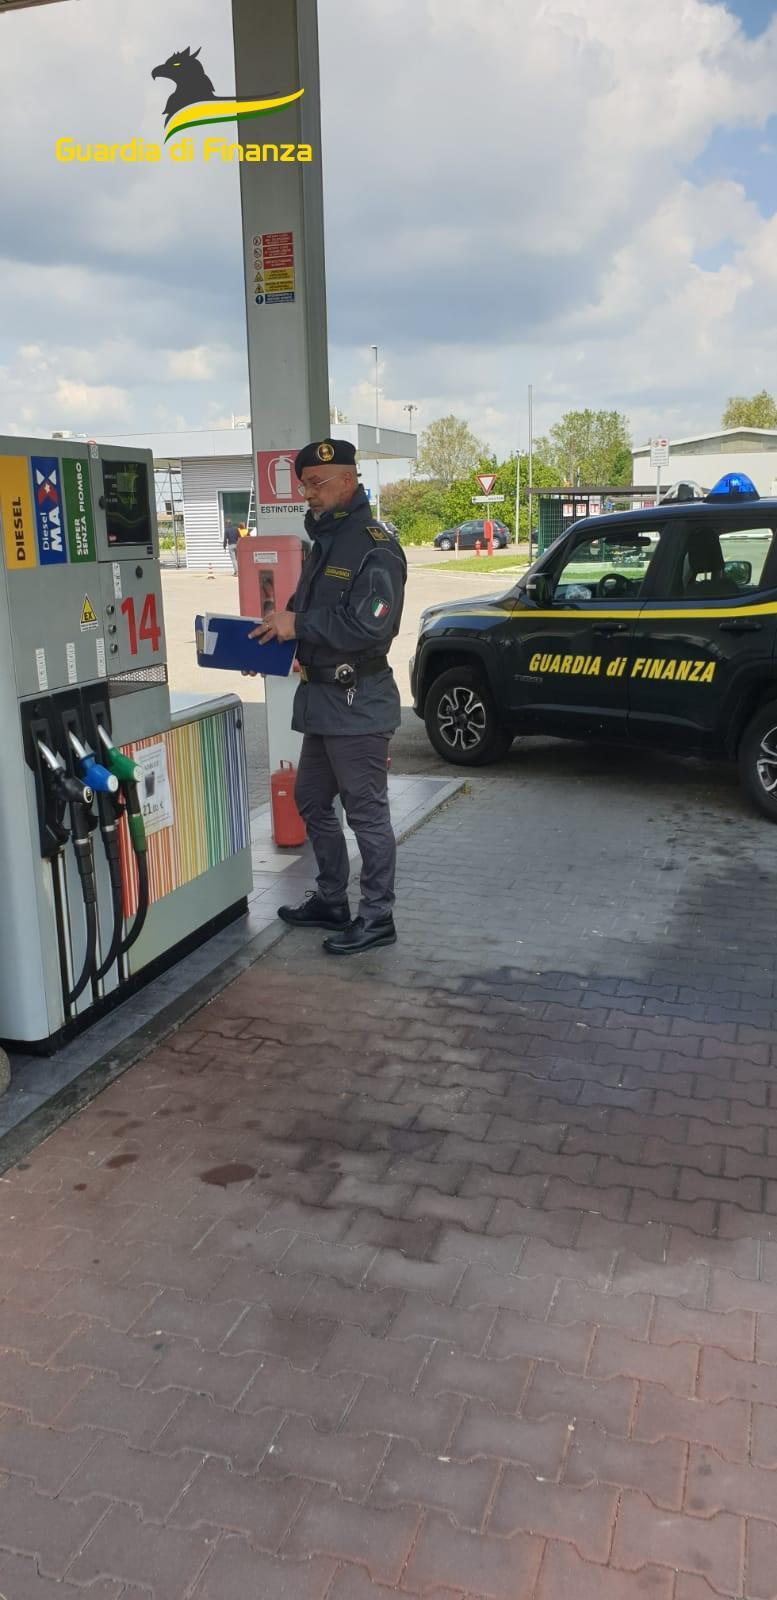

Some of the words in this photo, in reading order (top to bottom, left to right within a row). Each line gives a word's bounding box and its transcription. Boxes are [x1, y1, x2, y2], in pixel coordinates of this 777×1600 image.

[76, 462, 85, 512] PIOMBO
[12, 496, 26, 561] DIESEL
[260, 505, 305, 514] ESTINTORE
[40, 512, 50, 551] Diesel
[74, 518, 83, 556] SUPER
[80, 516, 89, 556] SENZA
[84, 612, 93, 621] EX
[120, 593, 162, 656] 14
[528, 653, 602, 676] GUARDIA
[605, 657, 628, 677] di
[630, 657, 717, 683] FINANZA
